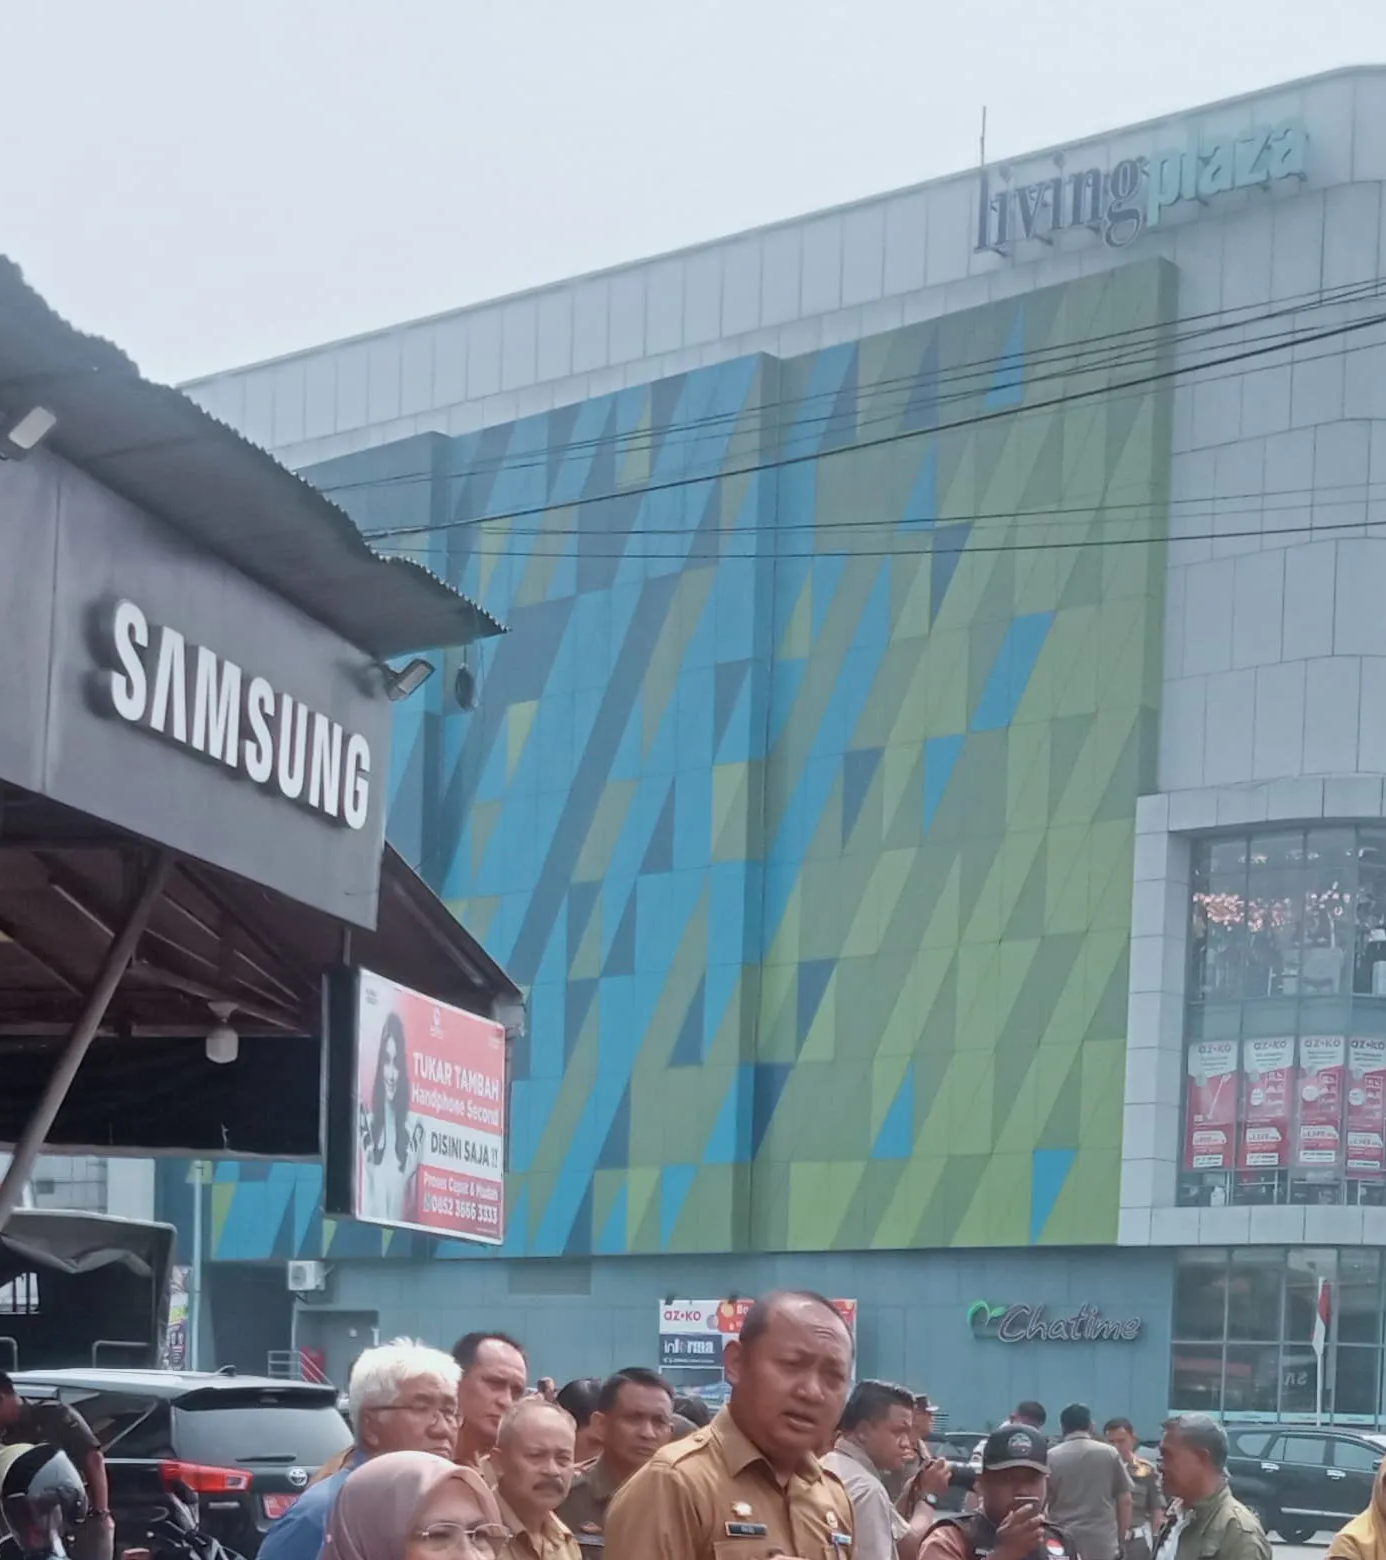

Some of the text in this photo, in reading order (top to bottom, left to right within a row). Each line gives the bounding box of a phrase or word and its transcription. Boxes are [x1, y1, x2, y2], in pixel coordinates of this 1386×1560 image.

[112, 598, 371, 830] SAMSUNG
[413, 1052, 499, 1101] TUKAR TAMBAH
[431, 1132, 461, 1162] DISINI
[464, 1140, 490, 1167] SAJA
[997, 1301, 1142, 1342] Chatime
